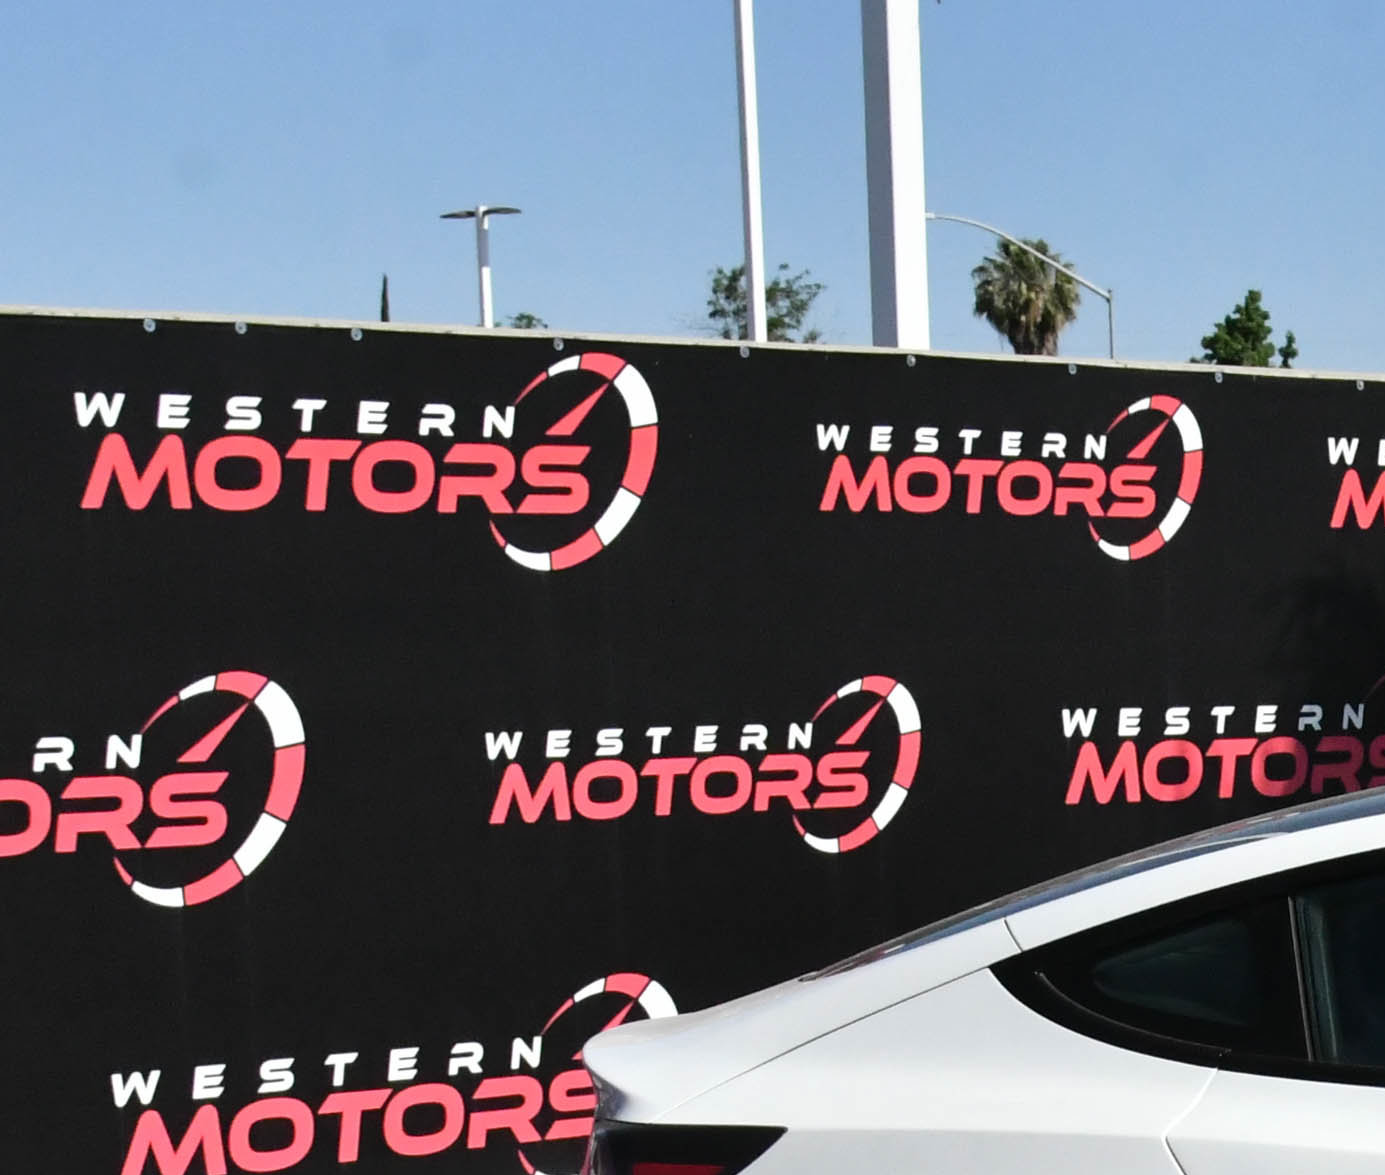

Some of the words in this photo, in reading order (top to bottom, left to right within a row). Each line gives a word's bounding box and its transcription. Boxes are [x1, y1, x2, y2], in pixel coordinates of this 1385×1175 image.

[74, 392, 516, 438] WESTERN
[816, 424, 1107, 459] WESTERN
[80, 433, 592, 514] MOTORS
[819, 454, 1158, 518] MOTORS
[485, 722, 814, 760] WESTERN
[1062, 704, 1364, 738] WESTERN
[488, 751, 871, 824] MOTORS
[110, 1036, 543, 1107] WESTERN
